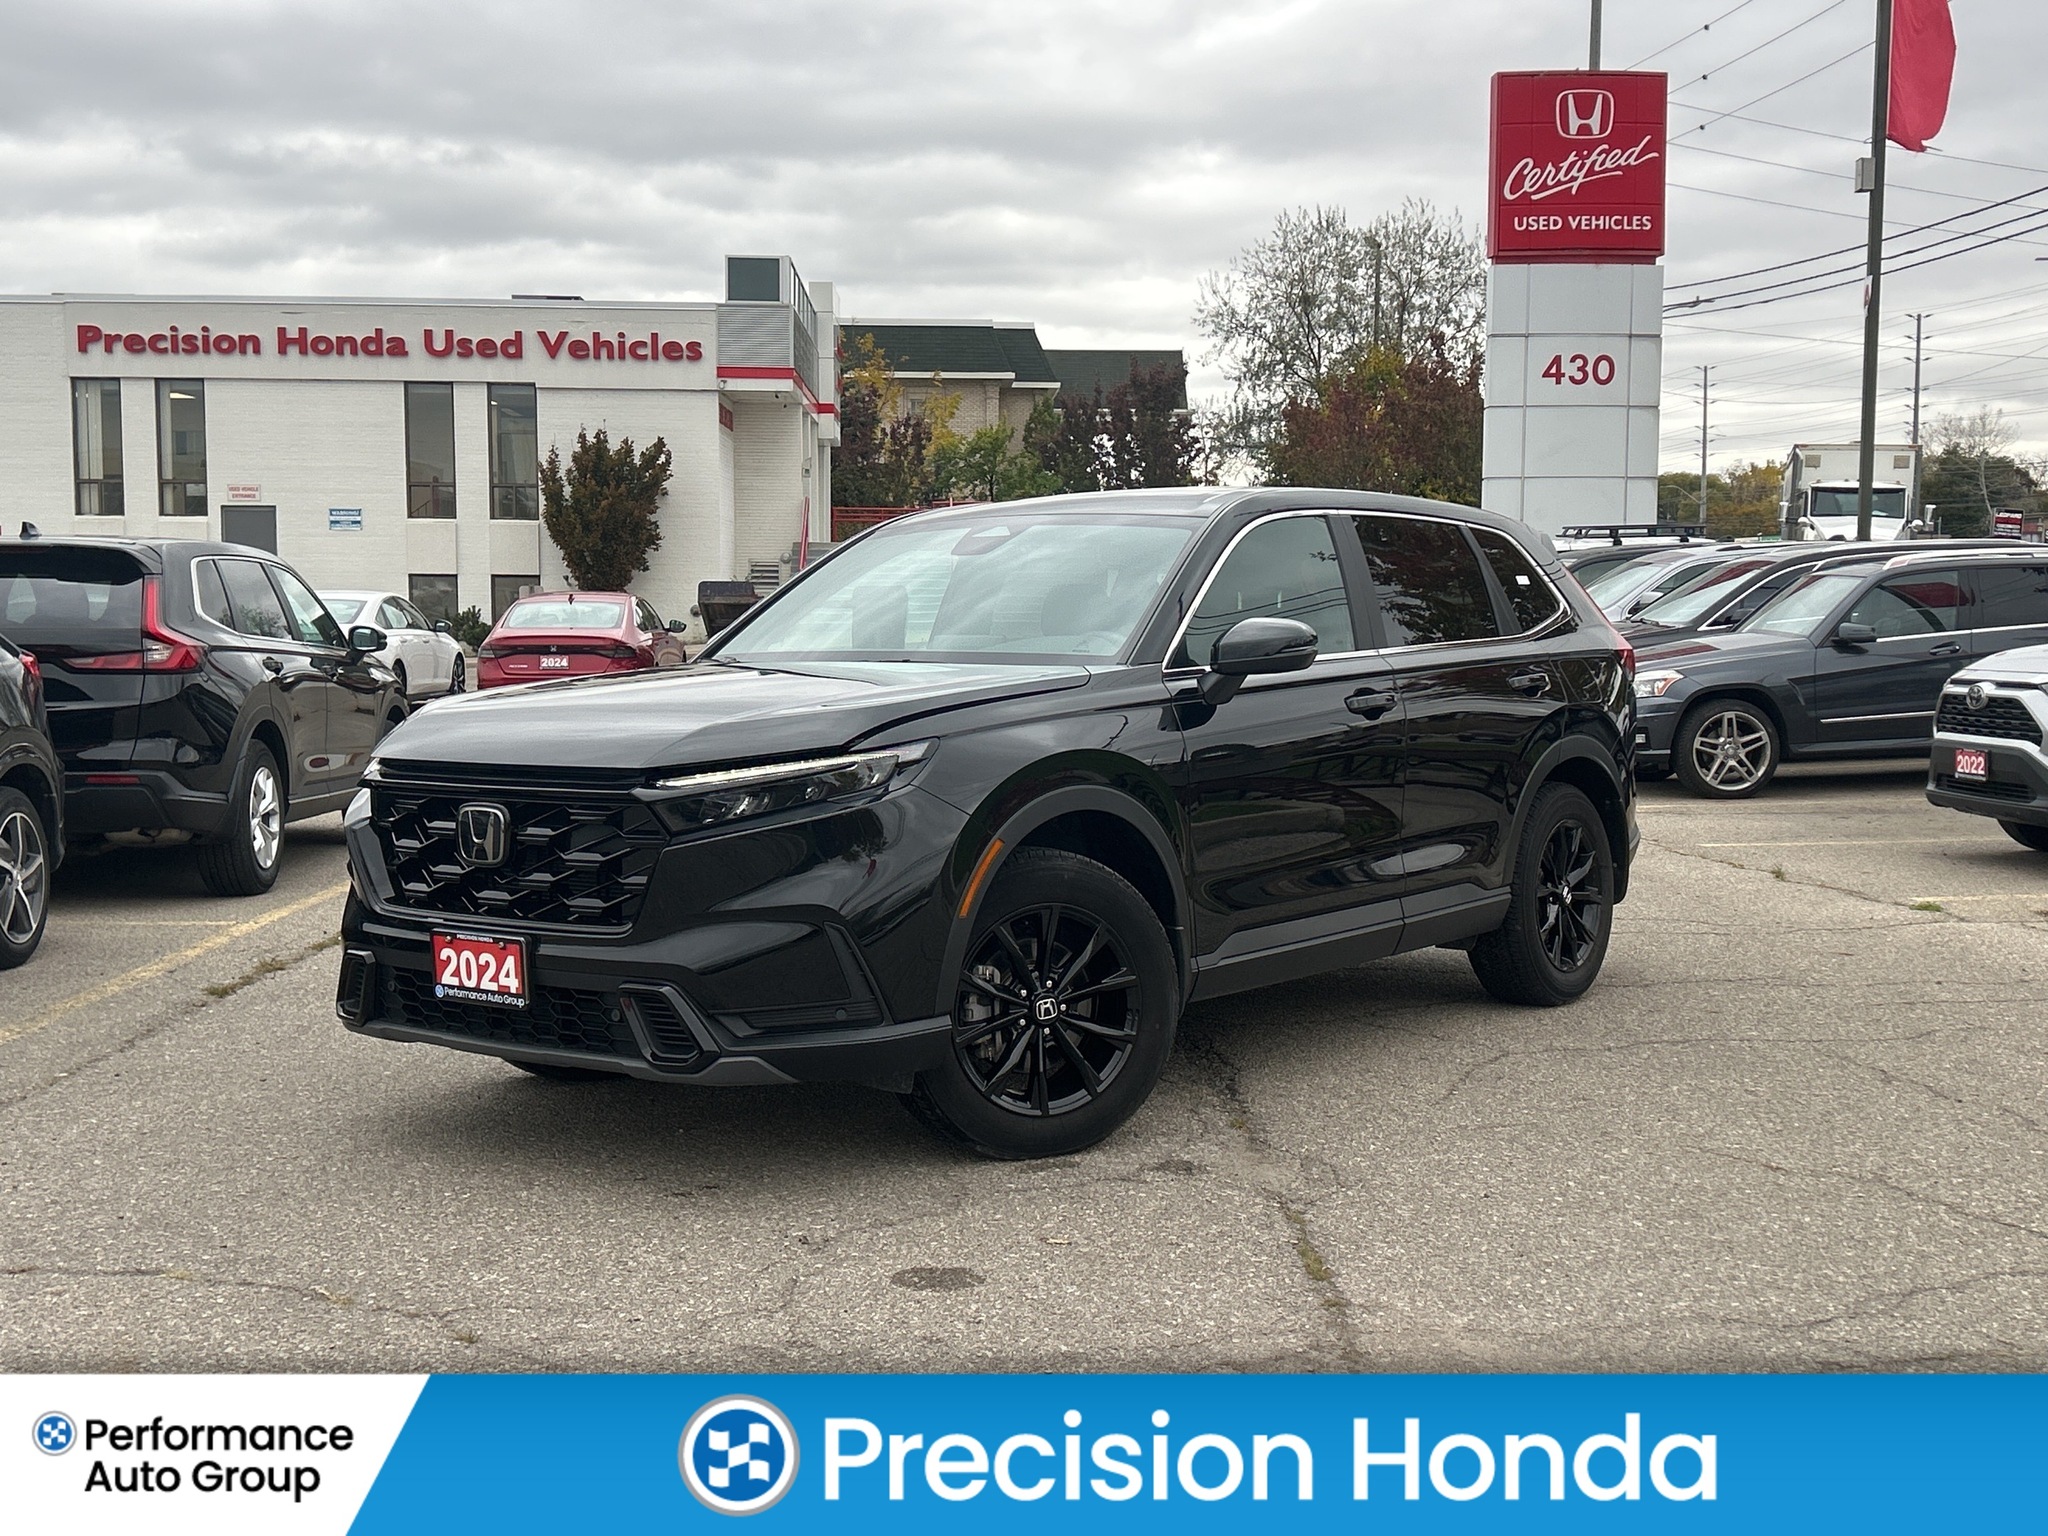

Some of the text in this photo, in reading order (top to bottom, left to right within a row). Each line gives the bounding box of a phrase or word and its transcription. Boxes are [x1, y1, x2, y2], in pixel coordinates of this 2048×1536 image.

[1503, 135, 1660, 200] Certified
[1514, 215, 1652, 231] USED VEHICLES
[77, 324, 704, 361] Precision Honda Used Vehicles
[1541, 353, 1616, 386] 430
[541, 658, 568, 667] 2024
[1956, 755, 1986, 775] 2022
[439, 947, 519, 994] 2024
[444, 987, 525, 1008] Performance Auto Group
